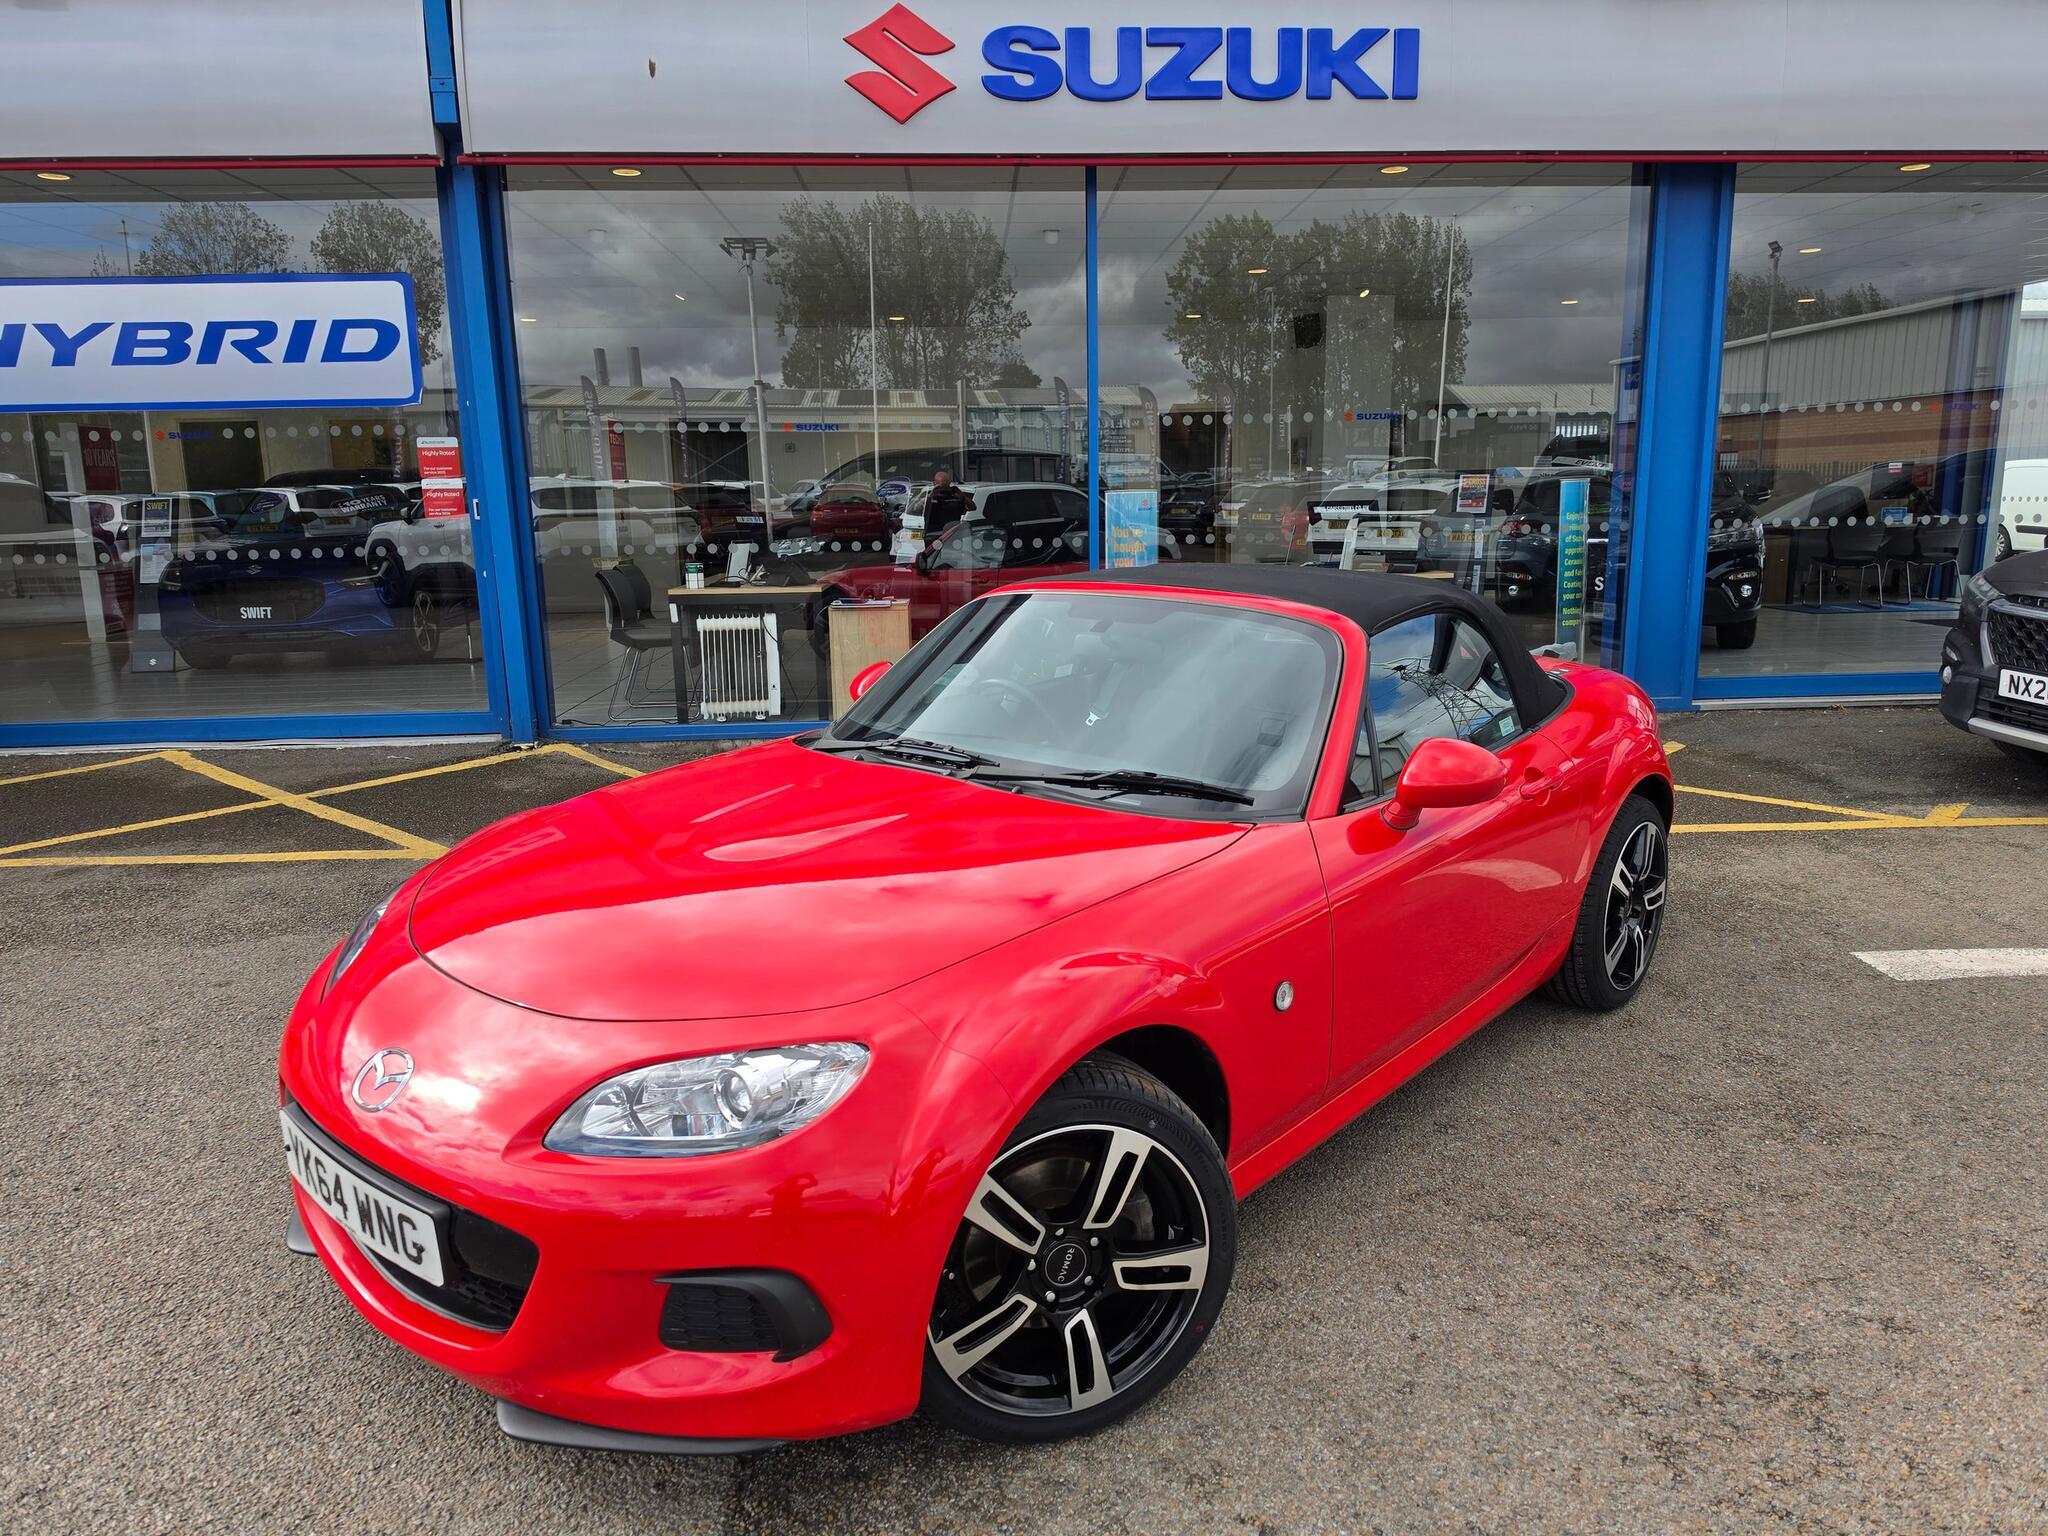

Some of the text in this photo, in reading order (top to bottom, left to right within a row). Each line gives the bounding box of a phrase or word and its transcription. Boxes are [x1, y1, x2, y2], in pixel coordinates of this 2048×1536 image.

[981, 25, 1420, 103] SUZUKI
[795, 423, 839, 432] SUZUKI
[240, 606, 272, 619] SWIFT
[2008, 674, 2048, 700] NX2
[288, 1126, 425, 1265] YK64 WNG
[1057, 1247, 1075, 1282] ROMAC
